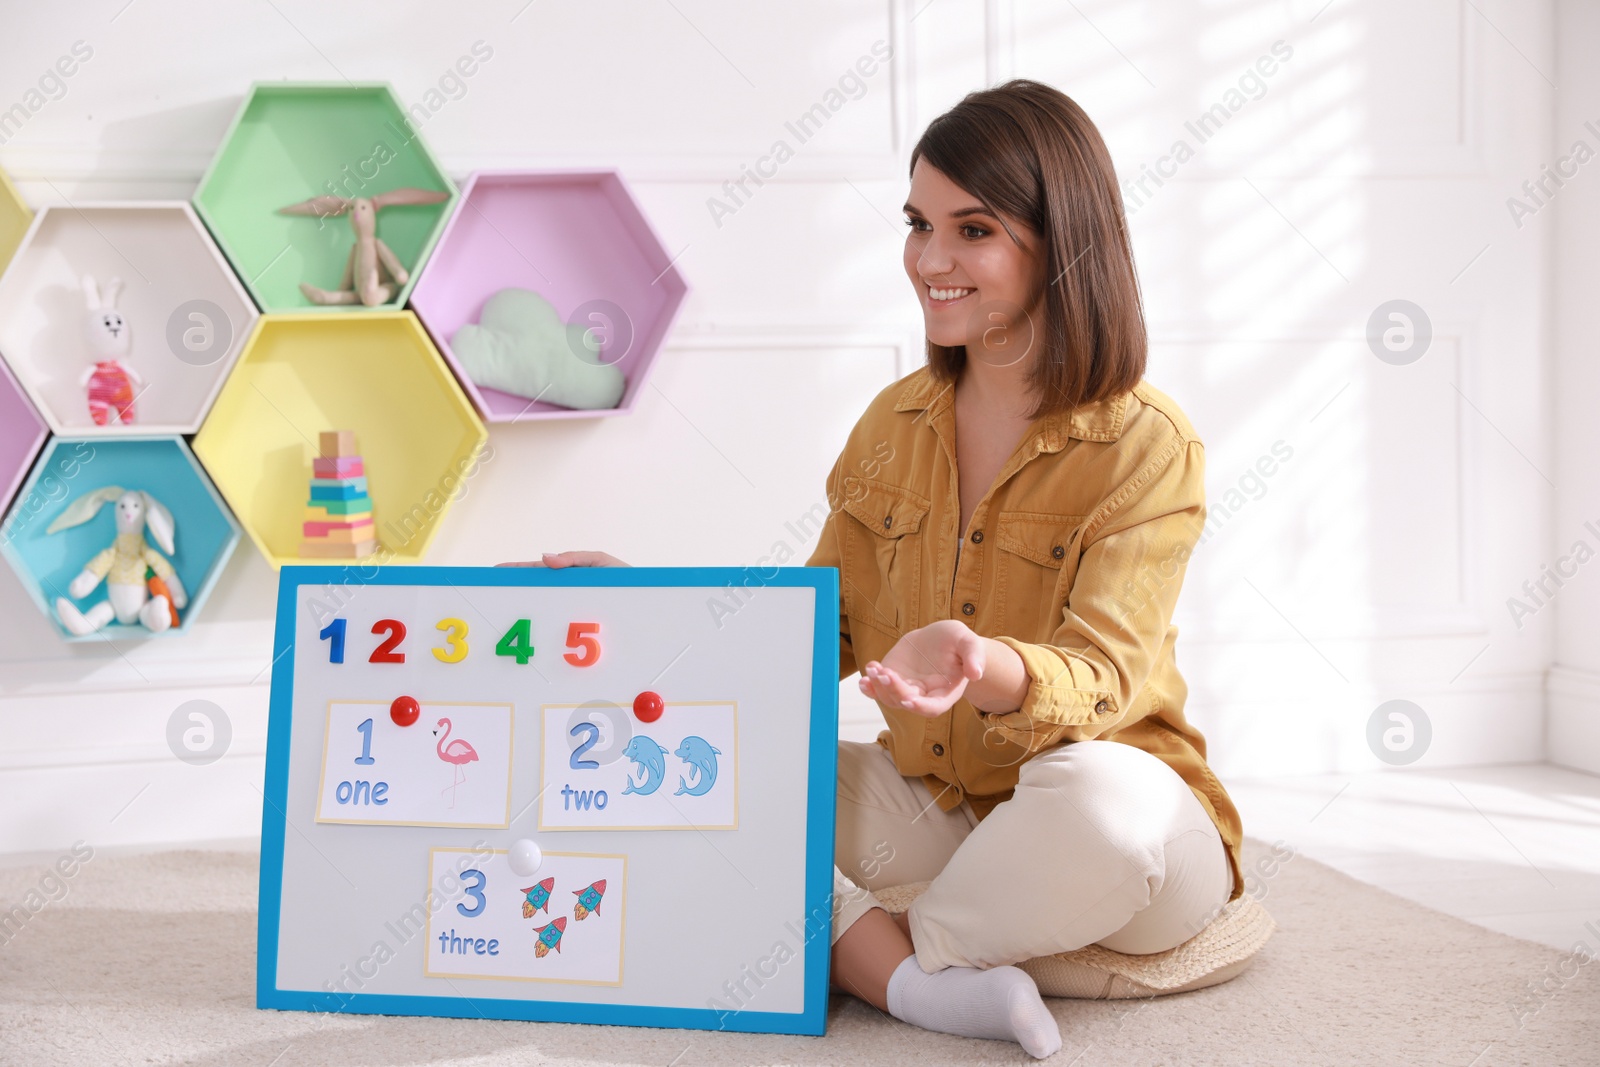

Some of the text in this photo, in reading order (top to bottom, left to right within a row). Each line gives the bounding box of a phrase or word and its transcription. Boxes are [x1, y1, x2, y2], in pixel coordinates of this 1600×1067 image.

[320, 617, 602, 668] 1 2 3 4 5
[354, 718, 375, 765] 1
[569, 722, 600, 770] 2
[336, 780, 389, 806] one
[560, 783, 609, 811] two
[456, 868, 487, 918] 3
[438, 928, 500, 956] three
